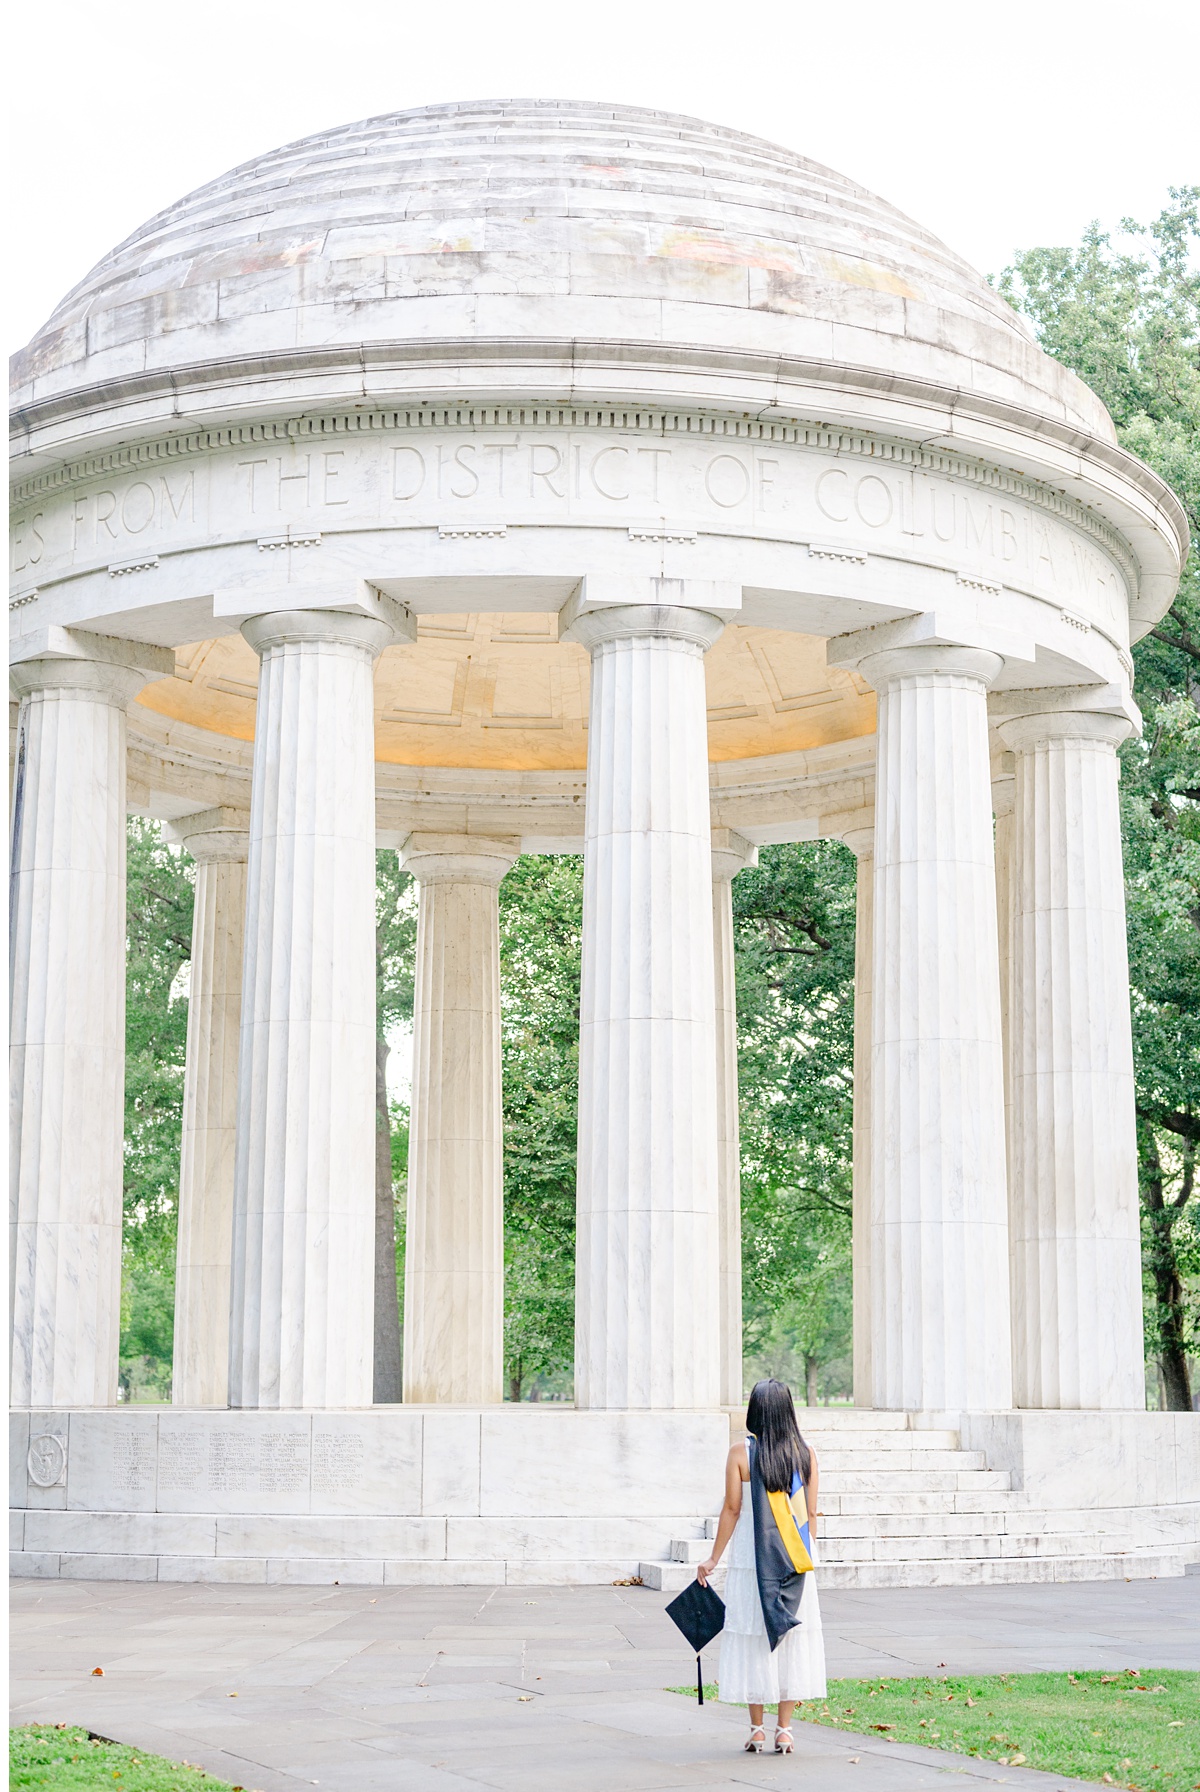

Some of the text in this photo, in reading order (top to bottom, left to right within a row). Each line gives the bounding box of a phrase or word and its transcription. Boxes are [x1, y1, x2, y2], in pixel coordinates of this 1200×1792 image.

[73, 470, 196, 551] FROM
[238, 450, 350, 515] THE
[389, 443, 672, 505] DISTRICT
[704, 453, 780, 513] OF
[814, 468, 1057, 582] COLUMBIA
